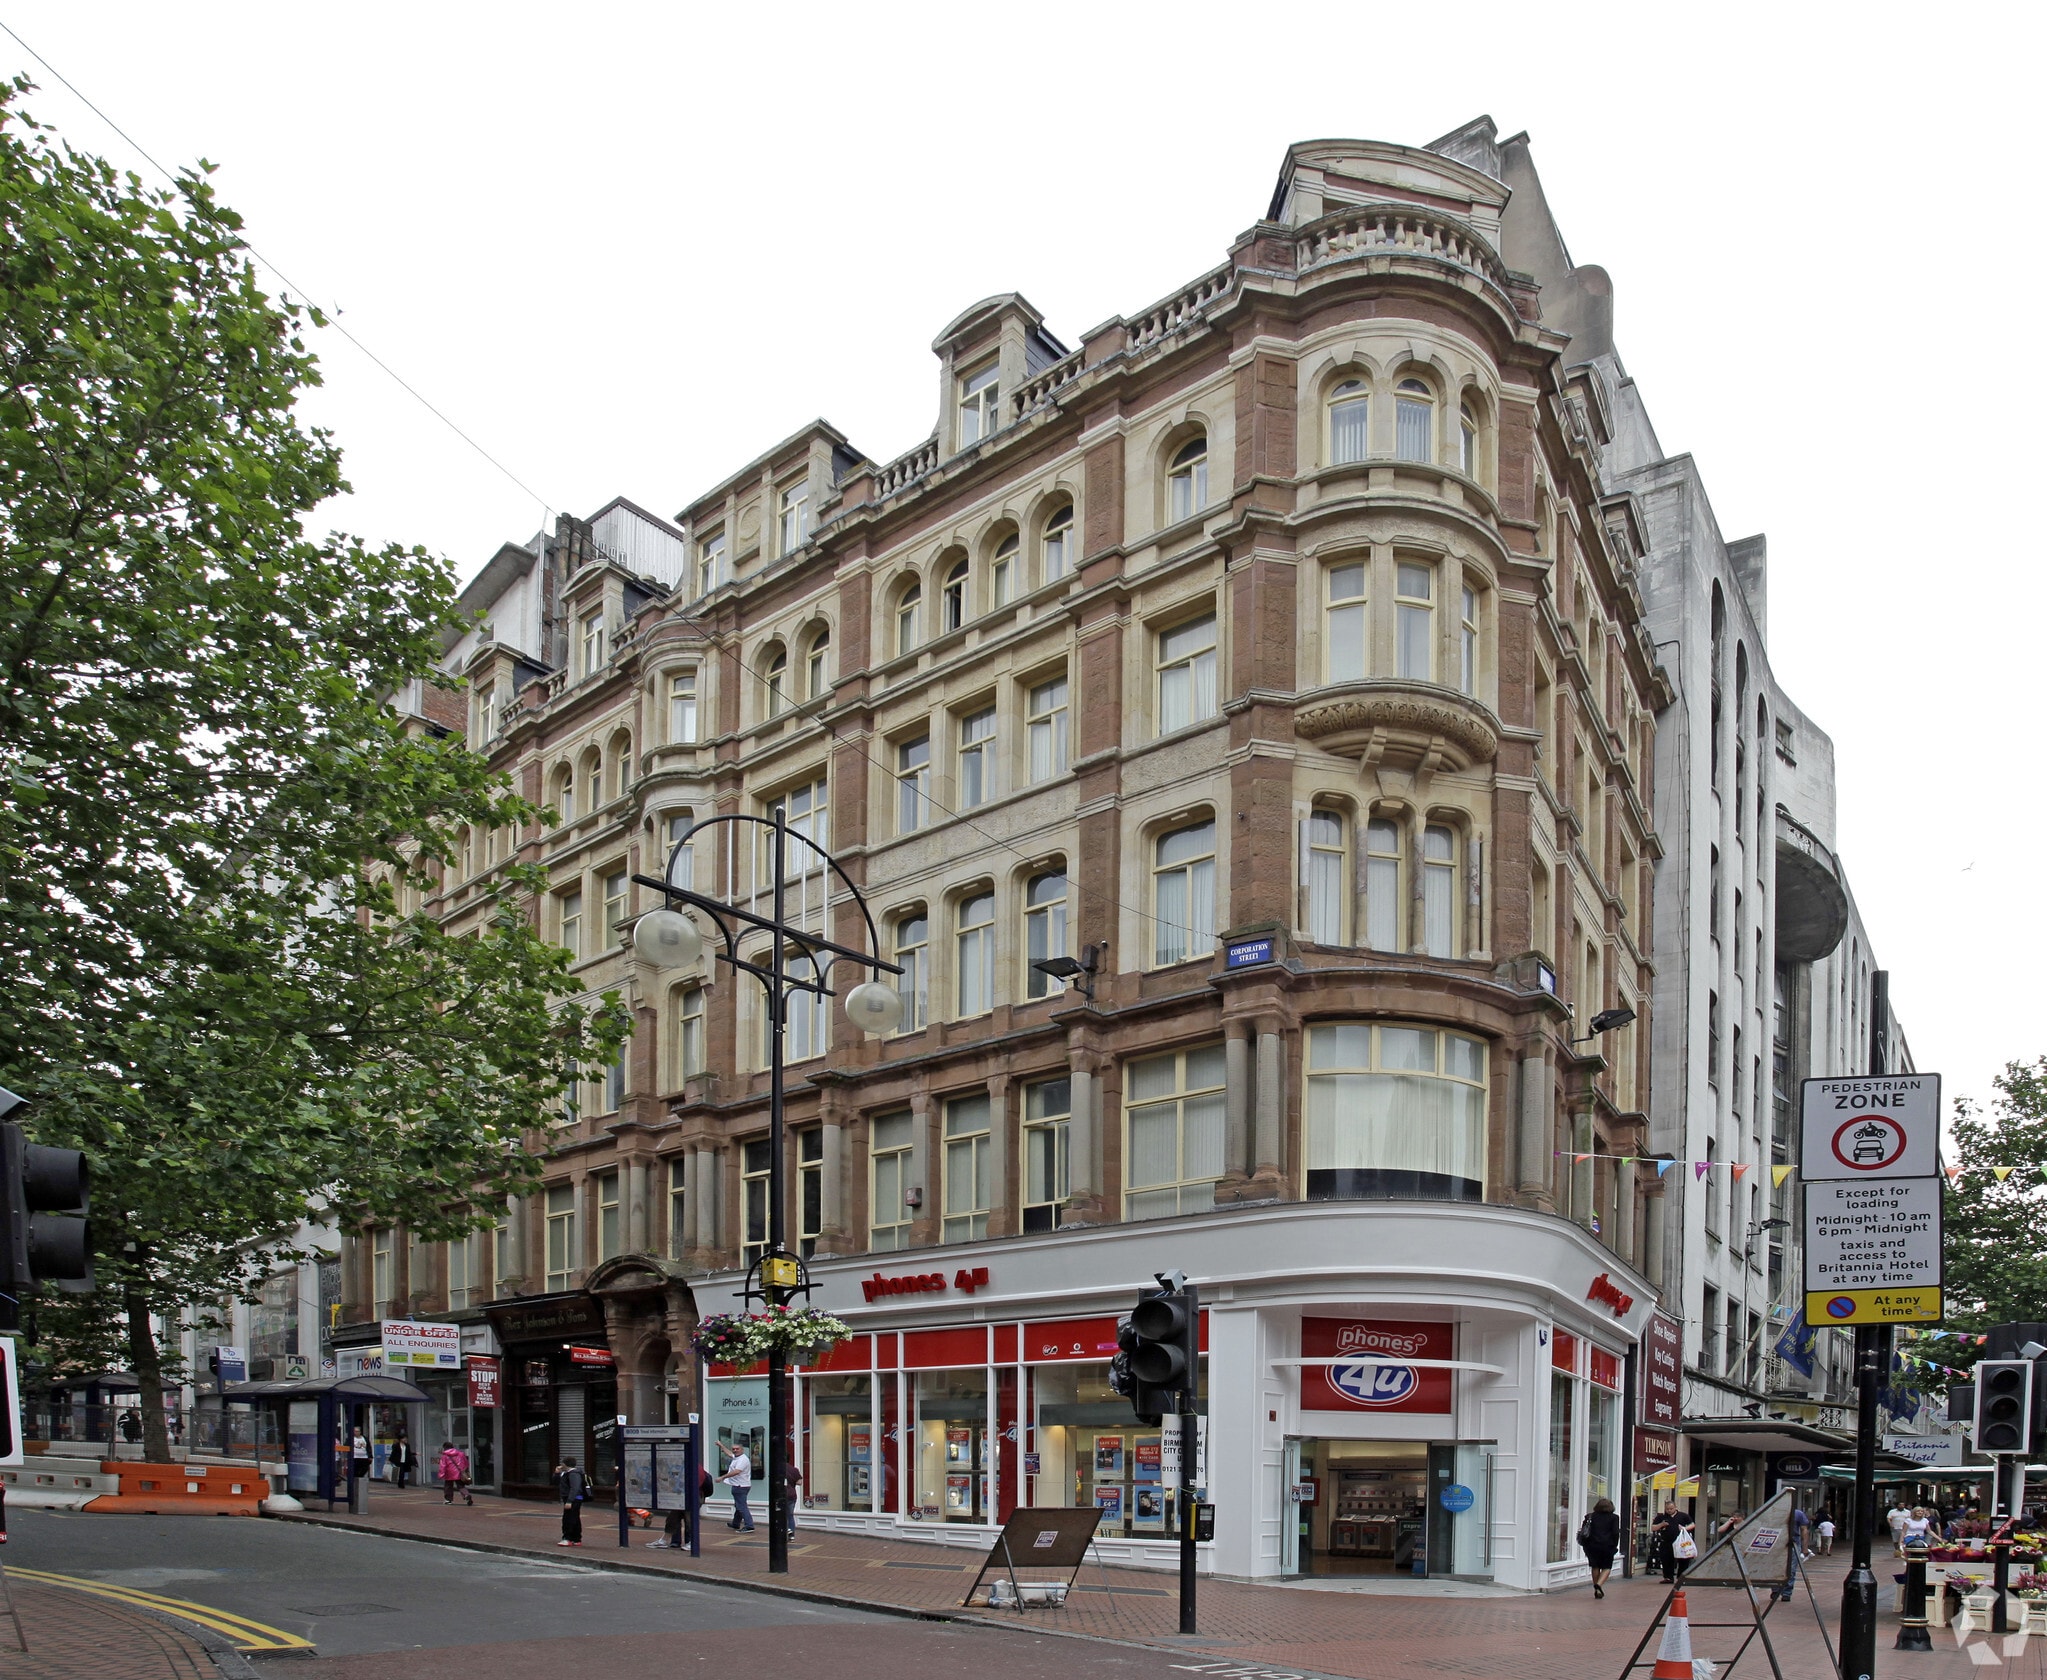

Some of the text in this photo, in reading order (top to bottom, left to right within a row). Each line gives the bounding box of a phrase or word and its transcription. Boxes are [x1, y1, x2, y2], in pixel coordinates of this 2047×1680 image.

[1230, 943, 1268, 956] CORPORATION
[1238, 953, 1258, 962] STREET
[1822, 1081, 1920, 1093] PEDESTRIAN
[1835, 1093, 1905, 1109] ZONE
[1836, 1187, 1910, 1198] Except for
[1846, 1200, 1898, 1209] loading
[1816, 1214, 1878, 1225] Midnight
[1890, 1212, 1906, 1221] 10
[1818, 1228, 1827, 1236] 6
[1831, 1227, 1852, 1237] pm
[1864, 1223, 1928, 1234] Midnight
[1841, 1239, 1905, 1250] taxis and
[1892, 1250, 1906, 1258] to
[1818, 1260, 1928, 1272] Britannia Hotel
[1833, 1272, 1913, 1284] at any time
[862, 1273, 947, 1302] phones
[1874, 1296, 1920, 1306] At any
[1882, 1307, 1912, 1316] time
[384, 1328, 422, 1336] UNDER
[1654, 1320, 1677, 1344] Shoe Repairs
[408, 1340, 456, 1349] ENQUIRIES
[1341, 1329, 1414, 1352] phones
[1662, 1350, 1675, 1372] Cutting
[471, 1370, 498, 1384] STOP!
[1652, 1372, 1677, 1394] Watch Repairs
[722, 1398, 747, 1407] iPhone
[1654, 1398, 1672, 1420] Engraving
[1645, 1436, 1672, 1457] TIMPSON
[1894, 1440, 1950, 1450] Britannia
